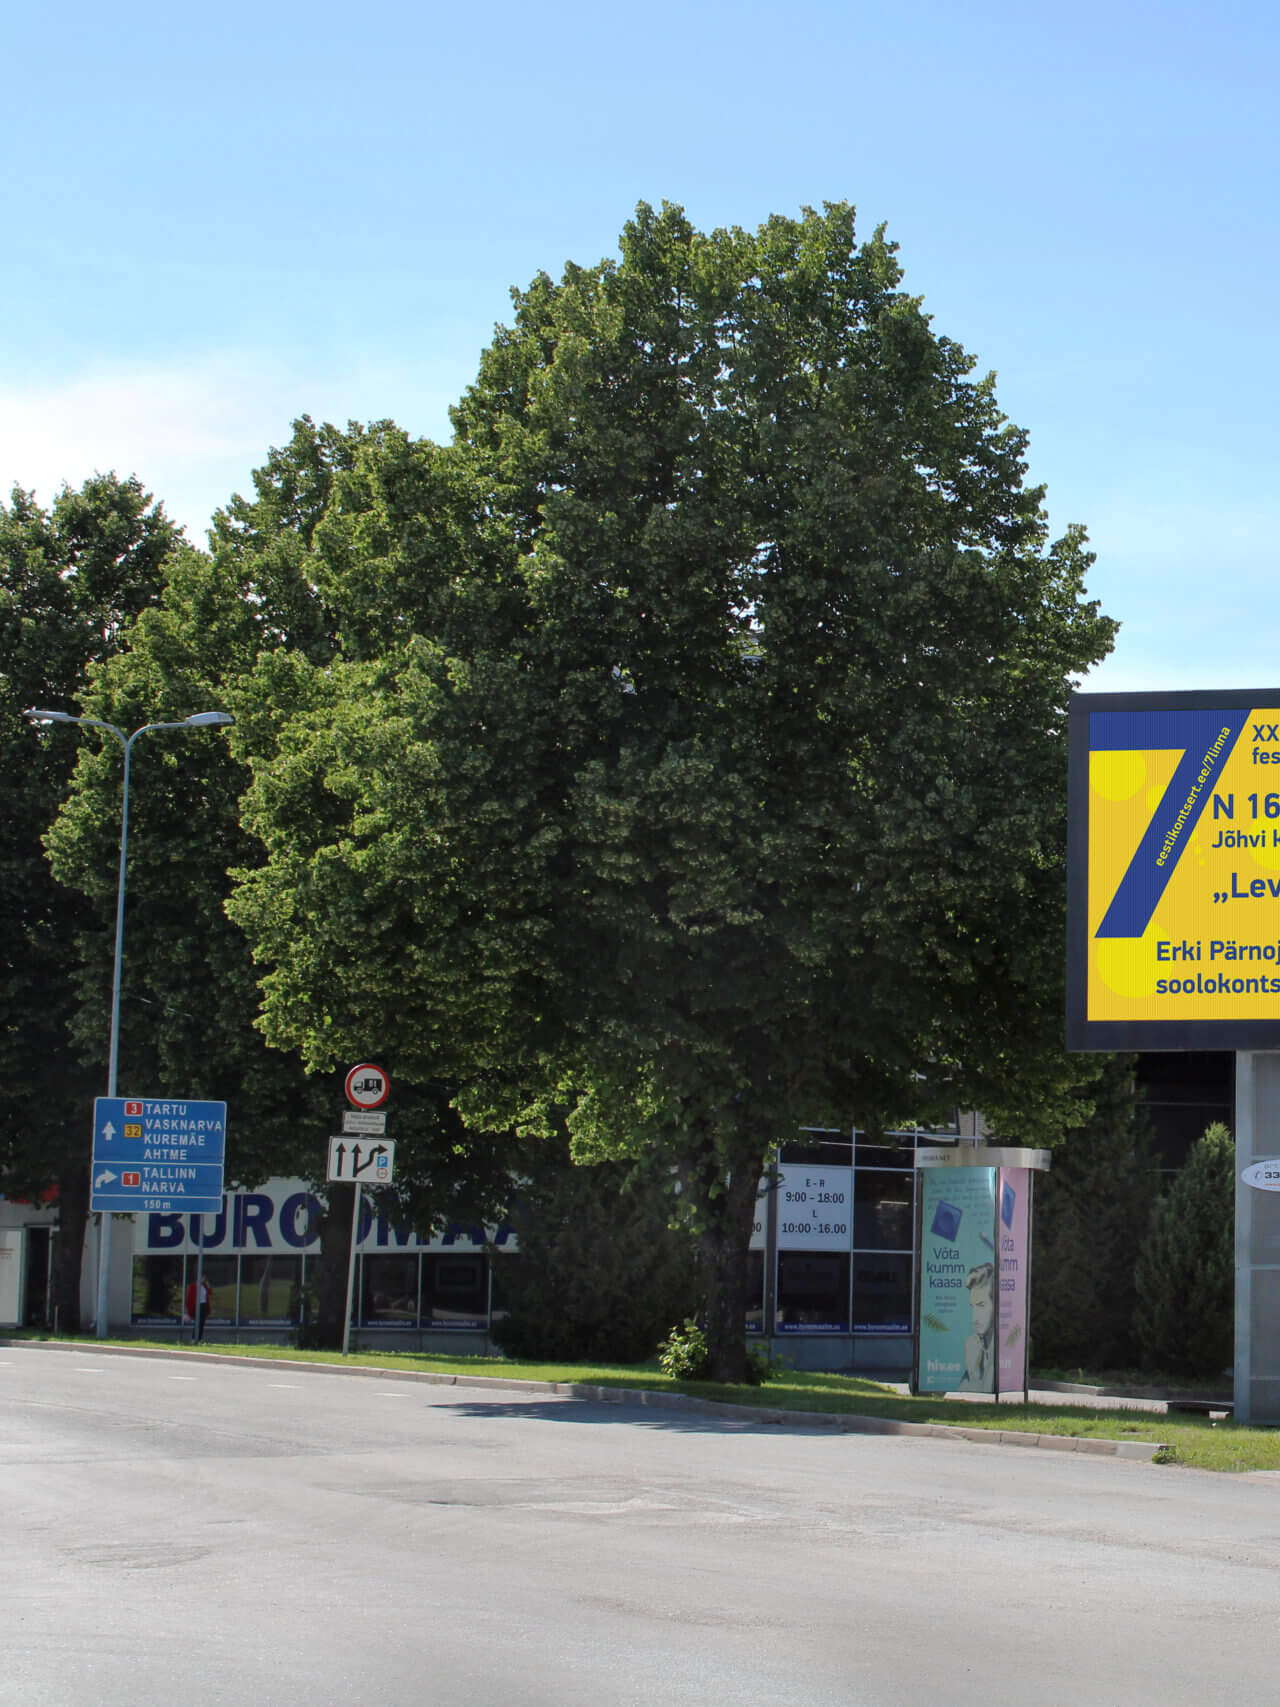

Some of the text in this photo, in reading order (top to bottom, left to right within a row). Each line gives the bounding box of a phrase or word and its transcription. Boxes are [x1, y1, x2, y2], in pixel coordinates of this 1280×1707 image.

[1155, 727, 1231, 867] eestikontsert.ee/7linna
[1213, 793, 1234, 820] N
[1212, 829, 1266, 848] Jõhvi
[1156, 940, 1201, 961] Erki
[130, 1103, 187, 1116] 3 TARTU
[125, 1125, 140, 1137] 32
[145, 1119, 223, 1131] VASKNARVA
[144, 1131, 206, 1146] KUREMÄE
[143, 1149, 188, 1160] AHTME
[143, 1167, 197, 1179] TALLINN
[1264, 1171, 1280, 1179] 33
[142, 1182, 185, 1193] NARVA
[785, 1191, 807, 1202] 9:00
[817, 1192, 845, 1204] 18:00
[144, 1200, 160, 1209] 150
[812, 1209, 818, 1218] L
[782, 1222, 811, 1233] 10:00
[927, 1261, 965, 1273] kumm
[930, 1276, 962, 1288] kaasa
